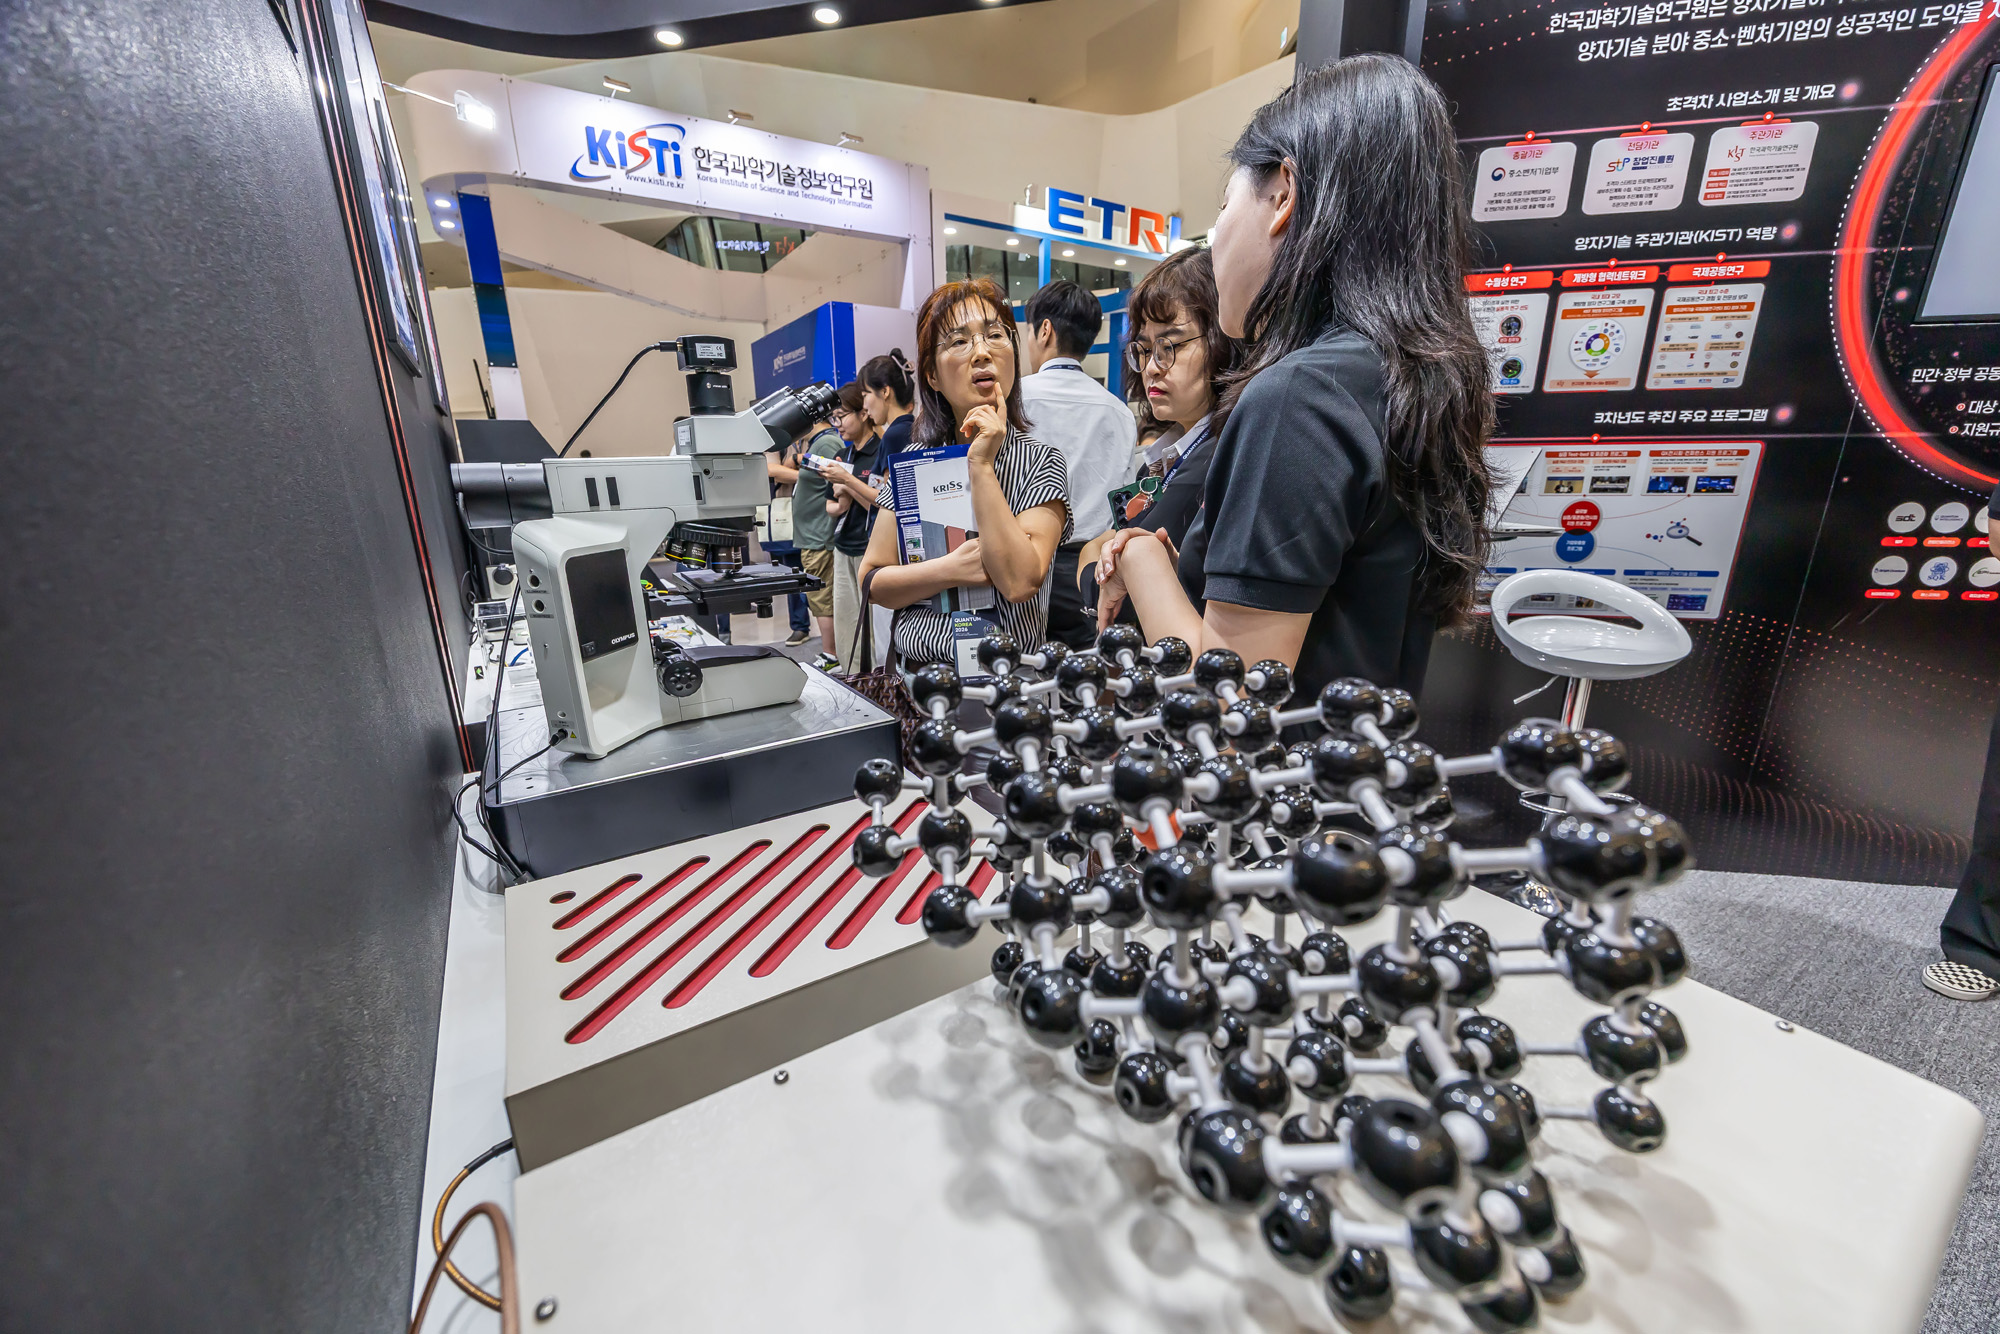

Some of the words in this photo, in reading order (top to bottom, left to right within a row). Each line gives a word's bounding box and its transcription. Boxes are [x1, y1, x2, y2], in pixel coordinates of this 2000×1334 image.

[1550, 0, 1727, 34] 한국과학기술연구원은
[1577, 36, 1648, 62] 양자기술
[1652, 31, 1690, 55] 분야
[1692, 17, 1832, 51] 중소·벤처기업의
[1836, 8, 1917, 37] 성공적인
[1919, 1, 1983, 28] 도약을
[1666, 94, 1714, 112] 초격차
[1715, 89, 1781, 108] 사업소개
[1783, 86, 1800, 103] 및
[1802, 83, 1836, 101] 개요
[1750, 130, 1782, 140] 주관기관
[1628, 140, 1660, 151] 전담기관
[692, 146, 873, 201] 한국과학기술정보연구원
[1508, 166, 1559, 178] 중소벤처기업부
[626, 174, 684, 189] www.kisti.re.kr
[697, 173, 718, 184] Korea
[719, 177, 748, 189] Institute
[759, 183, 785, 195] Science
[787, 188, 800, 198] and
[801, 190, 836, 205] Technology
[837, 198, 873, 209] Information
[1046, 186, 1182, 254] ETRI
[1574, 235, 1632, 250] 양자기술
[1634, 228, 1742, 247] 주관기관(KIST)
[1746, 226, 1778, 241] 역량
[1572, 272, 1597, 283] 개방형
[1598, 270, 1646, 282] 협력네트워크
[1692, 265, 1744, 277] 국제공동연구
[1510, 276, 1527, 286] 연구
[1912, 368, 1972, 383] 민간·정부
[1968, 400, 1998, 414] 대상
[1594, 411, 1645, 424] 3차년도
[1648, 411, 1676, 424] 추진
[1678, 410, 1707, 423] 주요
[1710, 409, 1768, 422] 프로그램
[933, 481, 963, 493] KRISS
[612, 633, 635, 645] OLYMPUS
